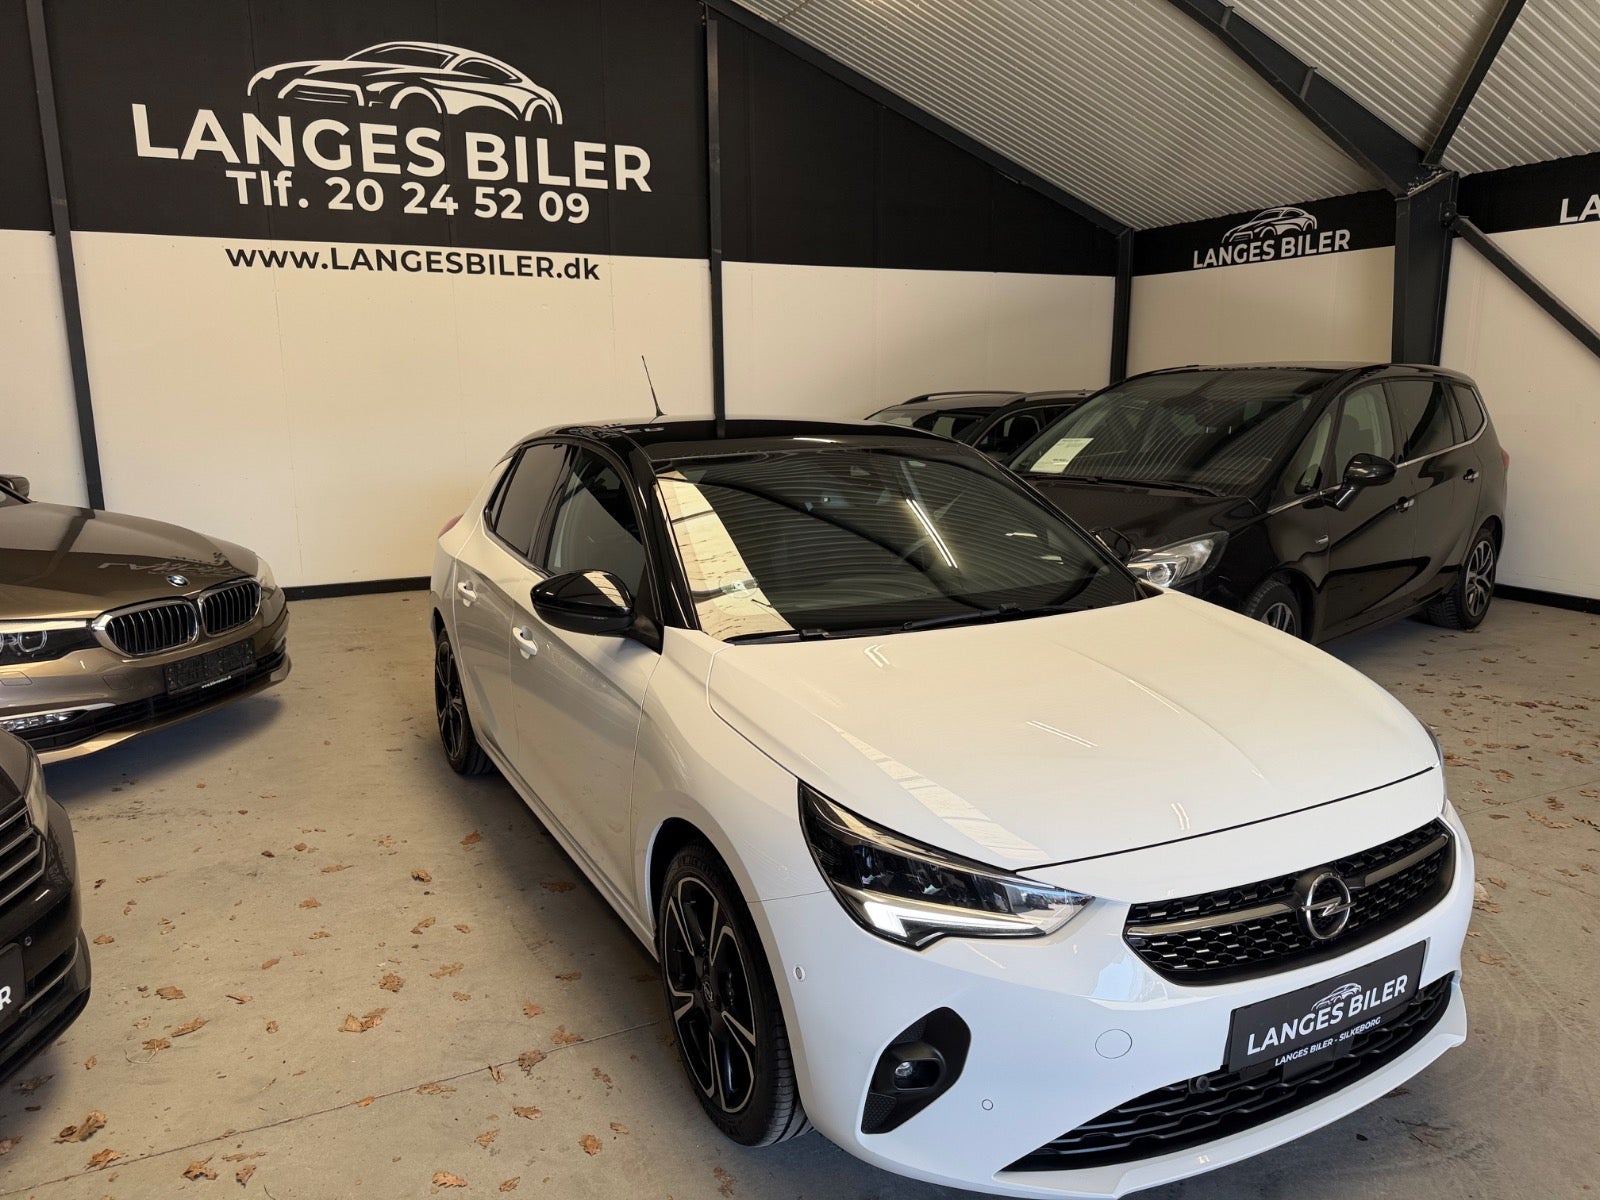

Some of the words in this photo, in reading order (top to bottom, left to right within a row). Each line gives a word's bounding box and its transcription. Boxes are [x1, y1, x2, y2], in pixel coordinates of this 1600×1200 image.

[131, 103, 446, 178] LANGES
[465, 131, 652, 193] BILER
[225, 169, 309, 209] Tlf.
[325, 176, 384, 212] 20
[401, 181, 459, 216] 24
[474, 186, 524, 220] 52
[538, 190, 590, 224] 09
[225, 247, 600, 281] www.LANGESBILER.dk
[1193, 237, 1275, 269] LANGES
[1280, 229, 1351, 258] BILER
[1247, 1001, 1345, 1056] LANGES
[1347, 974, 1408, 1018] BILER
[1274, 1048, 1308, 1067] LANGES
[1309, 1037, 1334, 1054] BILER
[1338, 1016, 1382, 1042] SILKEBORG
